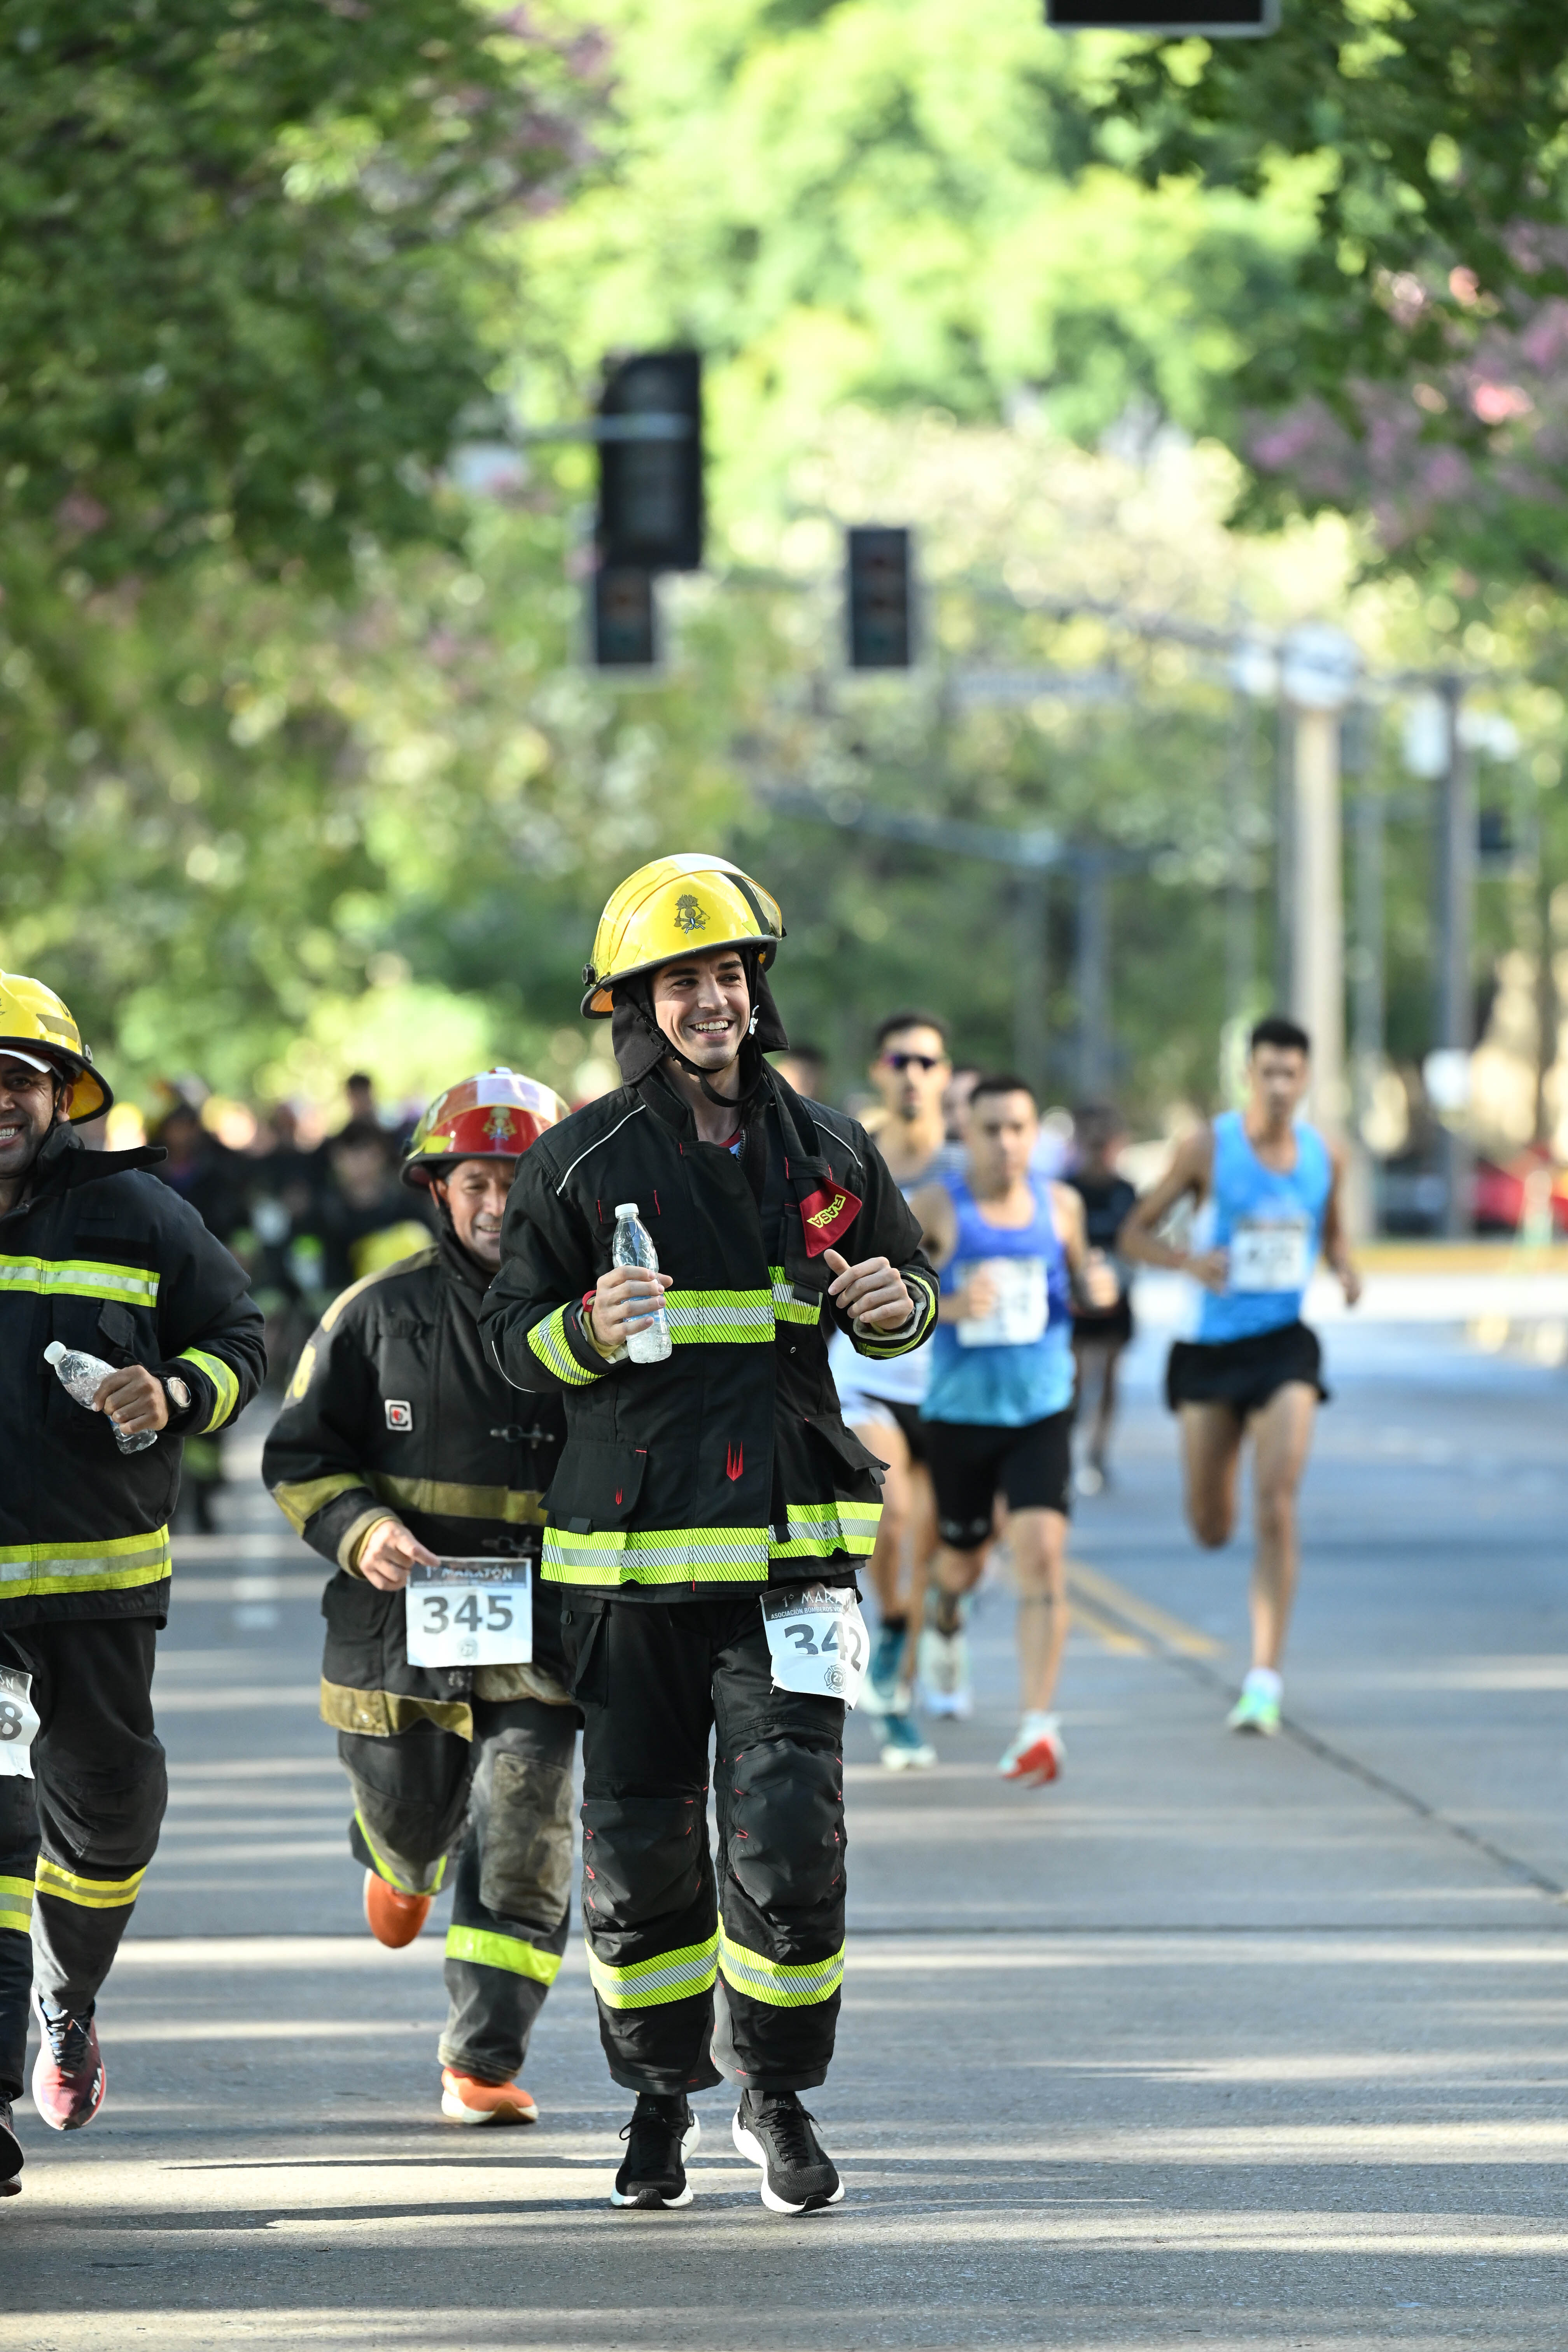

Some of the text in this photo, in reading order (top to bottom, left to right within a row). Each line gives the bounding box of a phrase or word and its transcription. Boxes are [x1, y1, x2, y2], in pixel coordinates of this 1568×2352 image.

[807, 1194, 846, 1228] RASA
[802, 1589, 843, 1604] MARA
[423, 1595, 513, 1634] 345
[771, 1608, 803, 1619] ASOCIACIÓN
[784, 1621, 861, 1671] 342
[833, 1672, 843, 1683] 27
